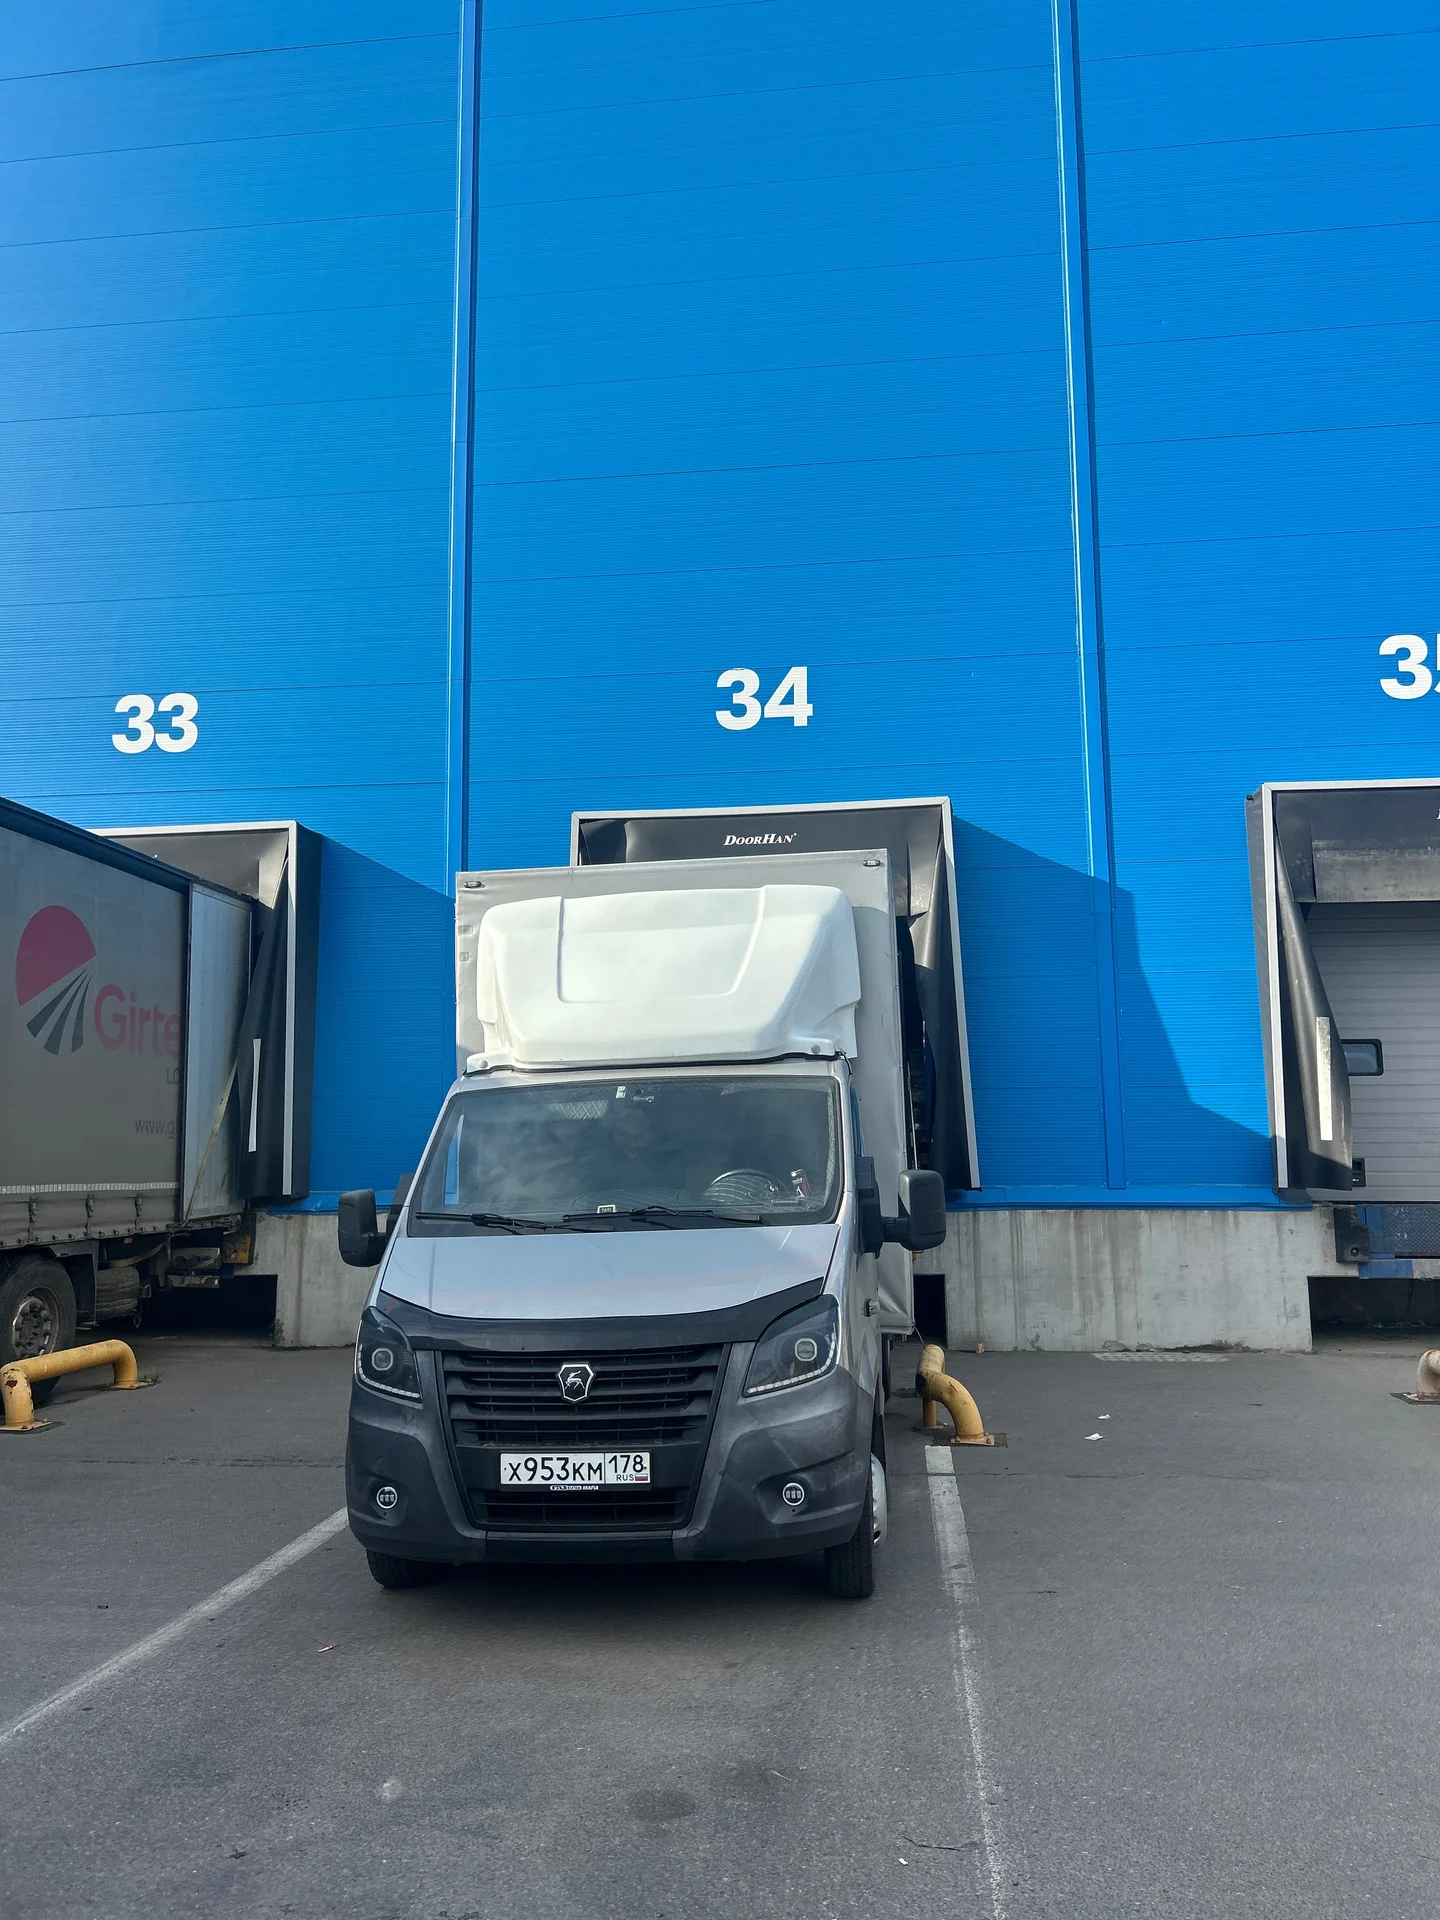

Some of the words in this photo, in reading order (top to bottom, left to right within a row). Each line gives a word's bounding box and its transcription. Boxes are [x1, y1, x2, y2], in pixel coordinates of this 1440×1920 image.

[715, 666, 813, 731] 34
[1379, 634, 1440, 700] 3
[111, 692, 199, 754] 33
[608, 1455, 644, 1473] 178
